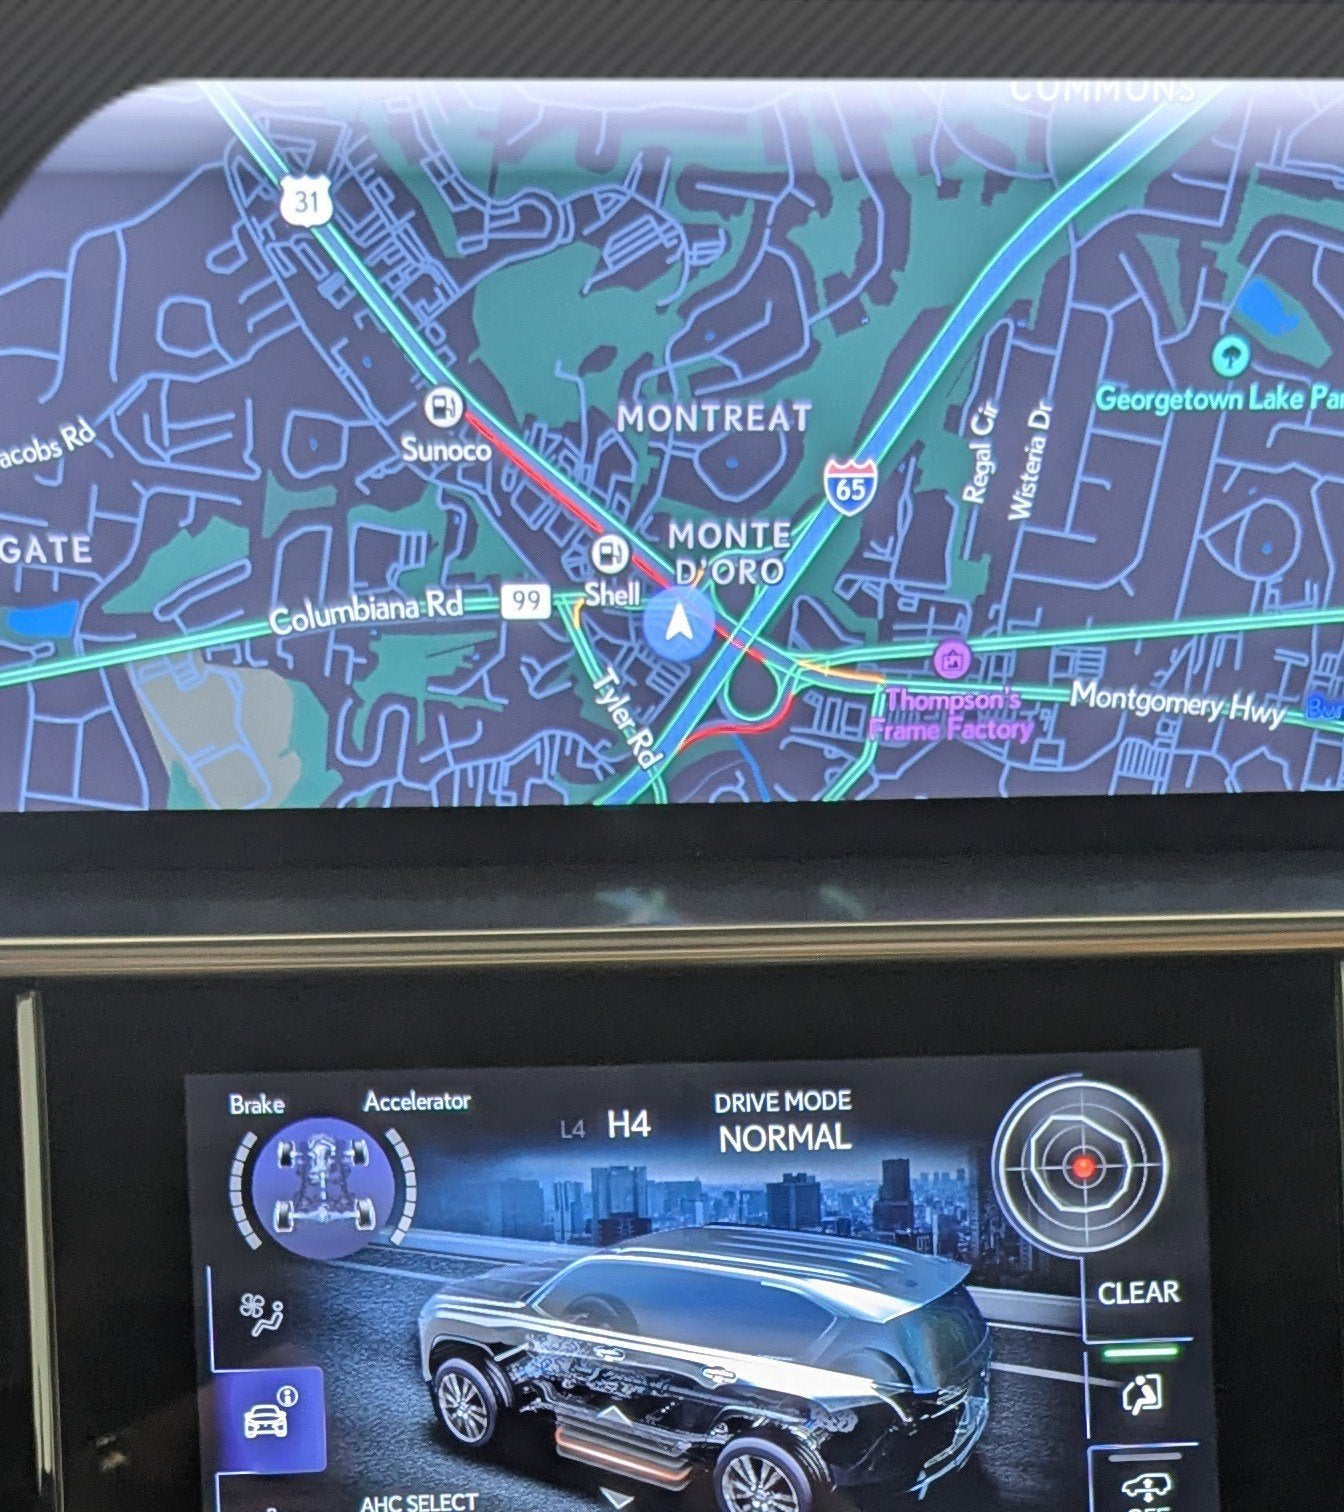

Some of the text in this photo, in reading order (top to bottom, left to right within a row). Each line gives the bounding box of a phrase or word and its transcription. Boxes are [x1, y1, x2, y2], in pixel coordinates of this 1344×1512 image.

[294, 190, 320, 214] 31
[1096, 385, 1242, 413] Georgetown
[1248, 384, 1304, 410] Lake
[617, 404, 812, 431] MONTREAT
[58, 417, 96, 447] Rd
[401, 437, 492, 464] Sunoco
[962, 399, 999, 504] Regal Cir
[1008, 400, 1053, 520] Wisteria Dr
[835, 480, 866, 500] 65
[669, 523, 790, 549] MONTE
[676, 558, 784, 585] D'ORO
[512, 591, 541, 611] 99
[585, 582, 640, 606] Shell
[269, 591, 463, 634] Columbiana Rd
[887, 687, 1021, 712] Thompson's
[1070, 682, 1285, 730] Montgomery Hwy
[593, 669, 657, 770] Tyler Rd
[870, 718, 1034, 744] Frame Factory
[229, 1094, 285, 1115] Brake
[363, 1090, 470, 1113] Accelerator
[714, 1089, 852, 1114] DRIVE MODE
[560, 1109, 651, 1140] L4 H4
[719, 1122, 852, 1154] NORMAL
[1098, 1280, 1179, 1305] CLEAR
[407, 1492, 479, 1512] SELECT
